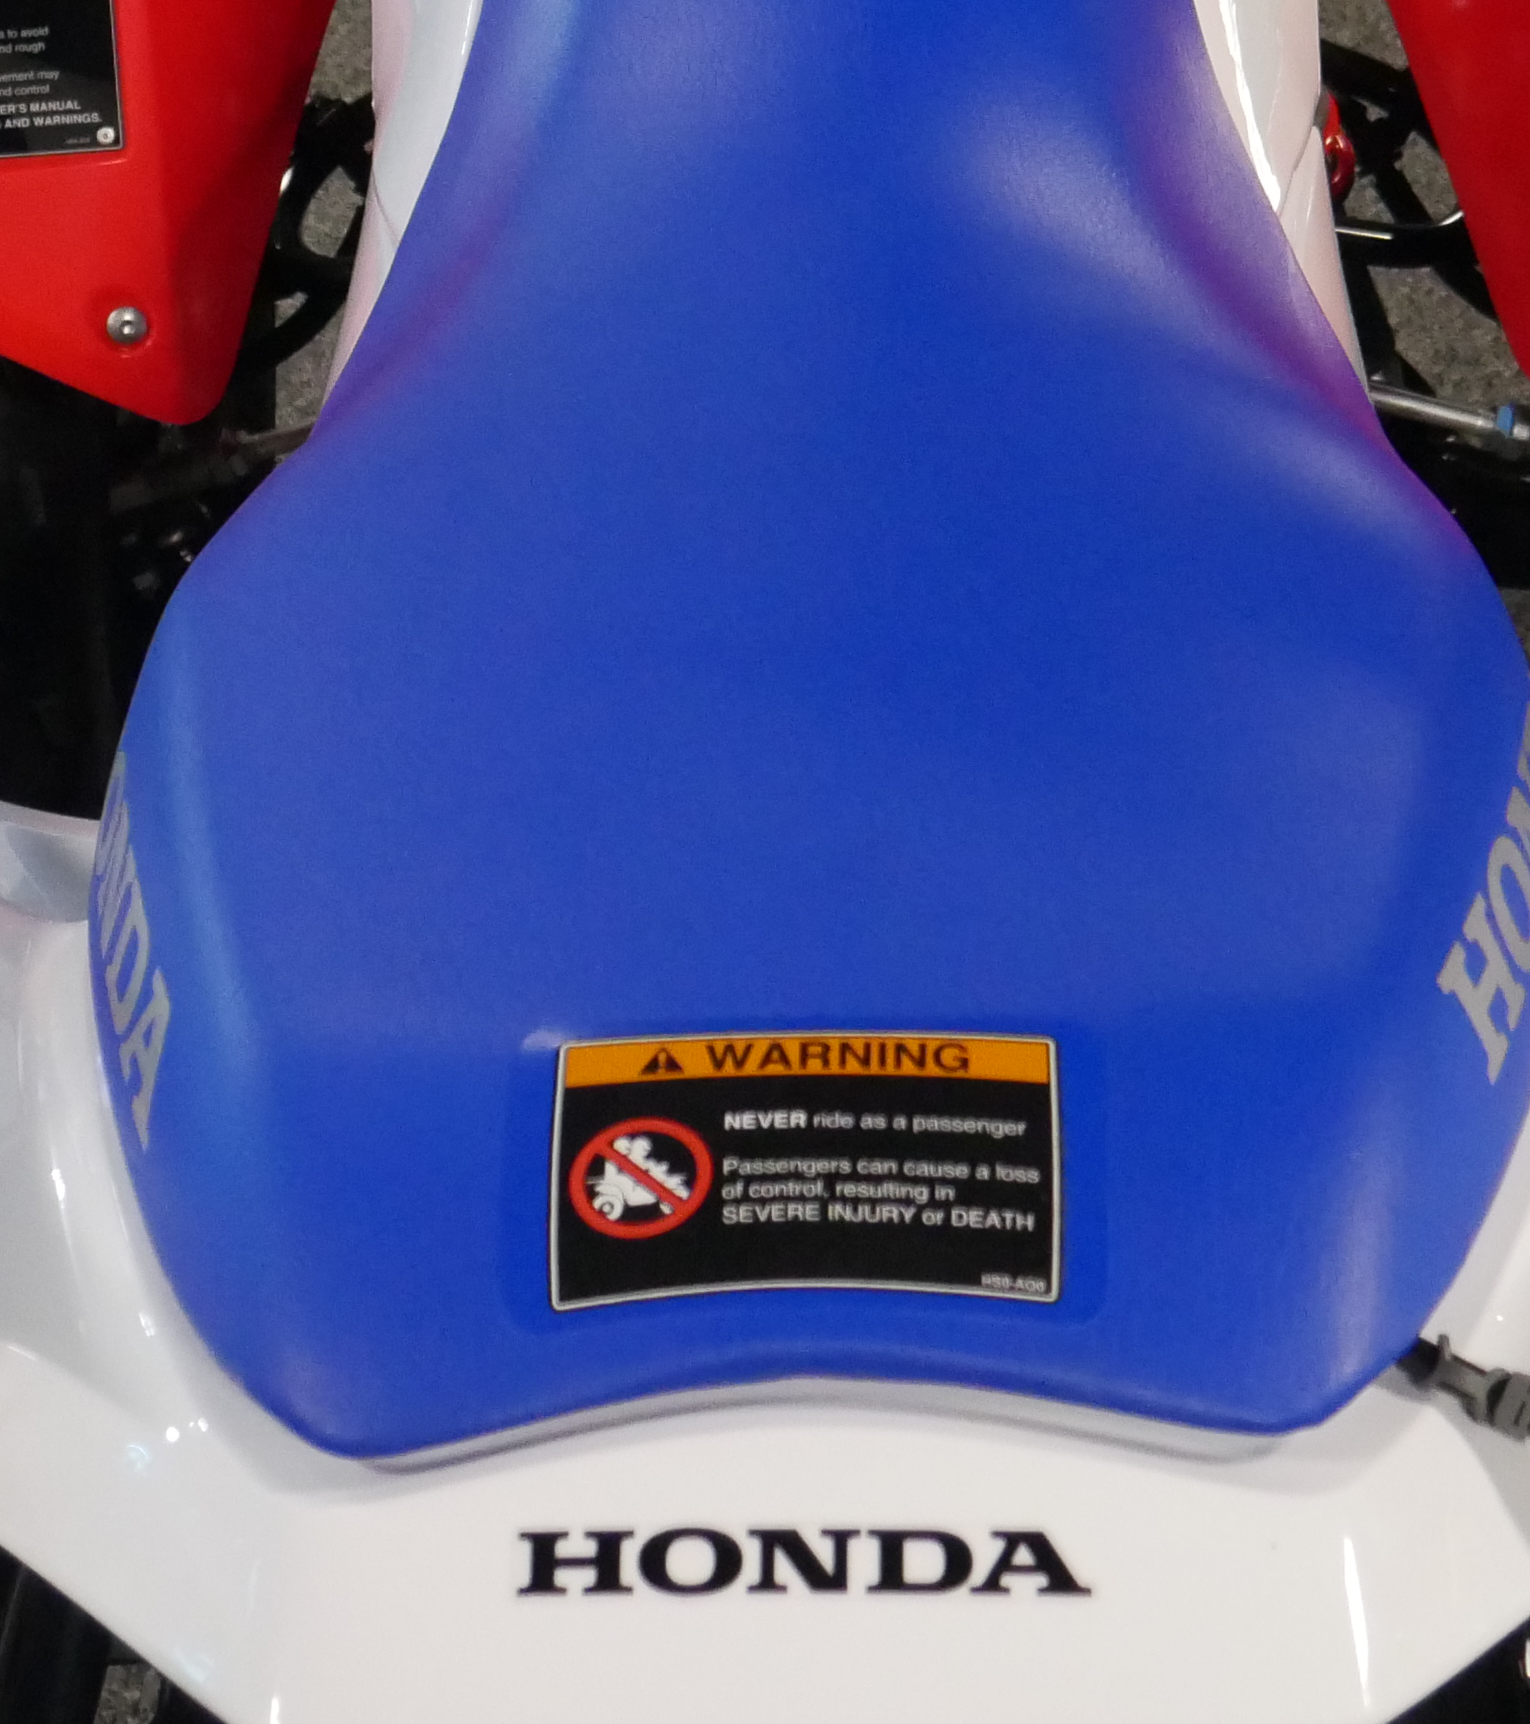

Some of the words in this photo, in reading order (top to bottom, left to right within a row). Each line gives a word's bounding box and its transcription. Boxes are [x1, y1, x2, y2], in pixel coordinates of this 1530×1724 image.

[4, 117, 29, 129] AND
[32, 112, 102, 127] WARNINGS.
[29, 99, 82, 113] MANUAL
[705, 1041, 970, 1075] WARNING
[723, 1109, 808, 1131] NEVER
[813, 1110, 855, 1129] ride
[860, 1112, 888, 1130] as
[892, 1114, 907, 1131] a
[912, 1114, 1027, 1139] passenger
[722, 1155, 853, 1178] Passengers
[856, 1156, 898, 1175] can
[903, 1158, 970, 1179] cause
[975, 1163, 991, 1181] a
[995, 1162, 1041, 1184] loss
[721, 1178, 744, 1200] of
[748, 1177, 830, 1199] control,
[835, 1178, 930, 1204] resulting
[934, 1183, 955, 1201] in
[722, 1200, 820, 1225] SEVERE
[828, 1200, 917, 1224] INJURY
[921, 1208, 944, 1226] or
[950, 1206, 1036, 1232] DEATH
[517, 1528, 1093, 1598] HONDA
